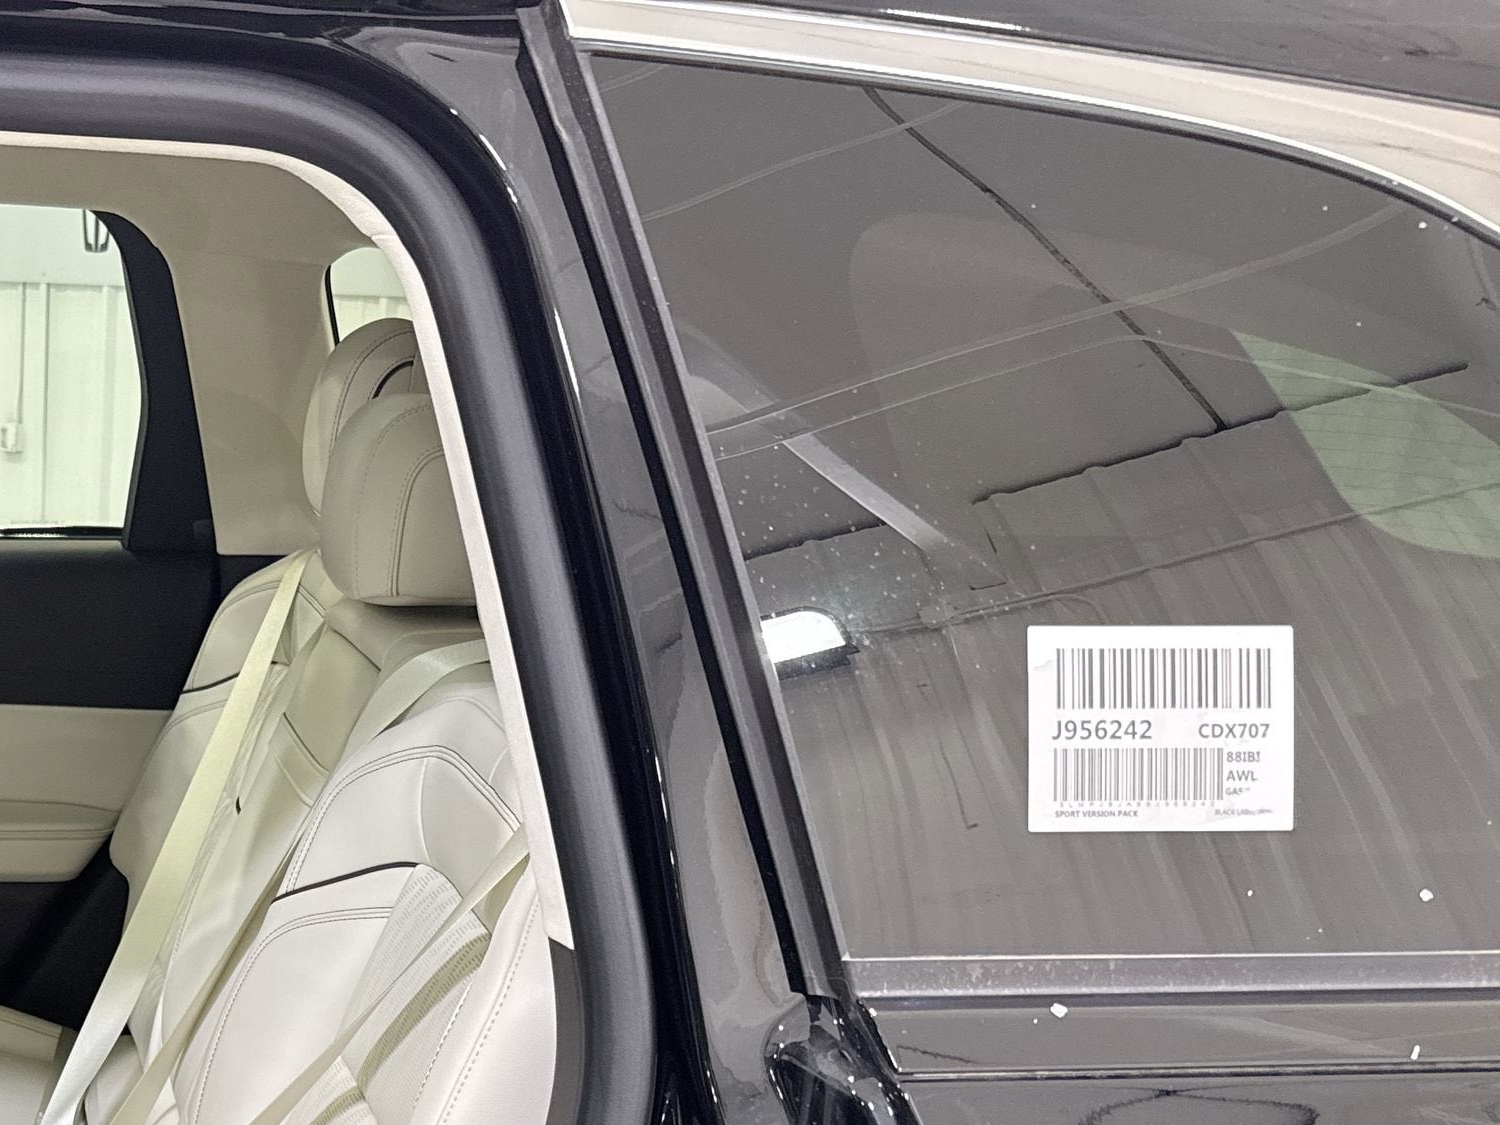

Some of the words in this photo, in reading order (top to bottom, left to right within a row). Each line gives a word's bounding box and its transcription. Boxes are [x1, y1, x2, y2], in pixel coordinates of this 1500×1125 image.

[1052, 720, 1152, 740] J956242
[1199, 723, 1269, 738] CDX707
[1226, 770, 1257, 782] AWL
[1055, 810, 1080, 818] SPORT
[1082, 810, 1116, 818] VERSION
[1118, 810, 1139, 818] PACK
